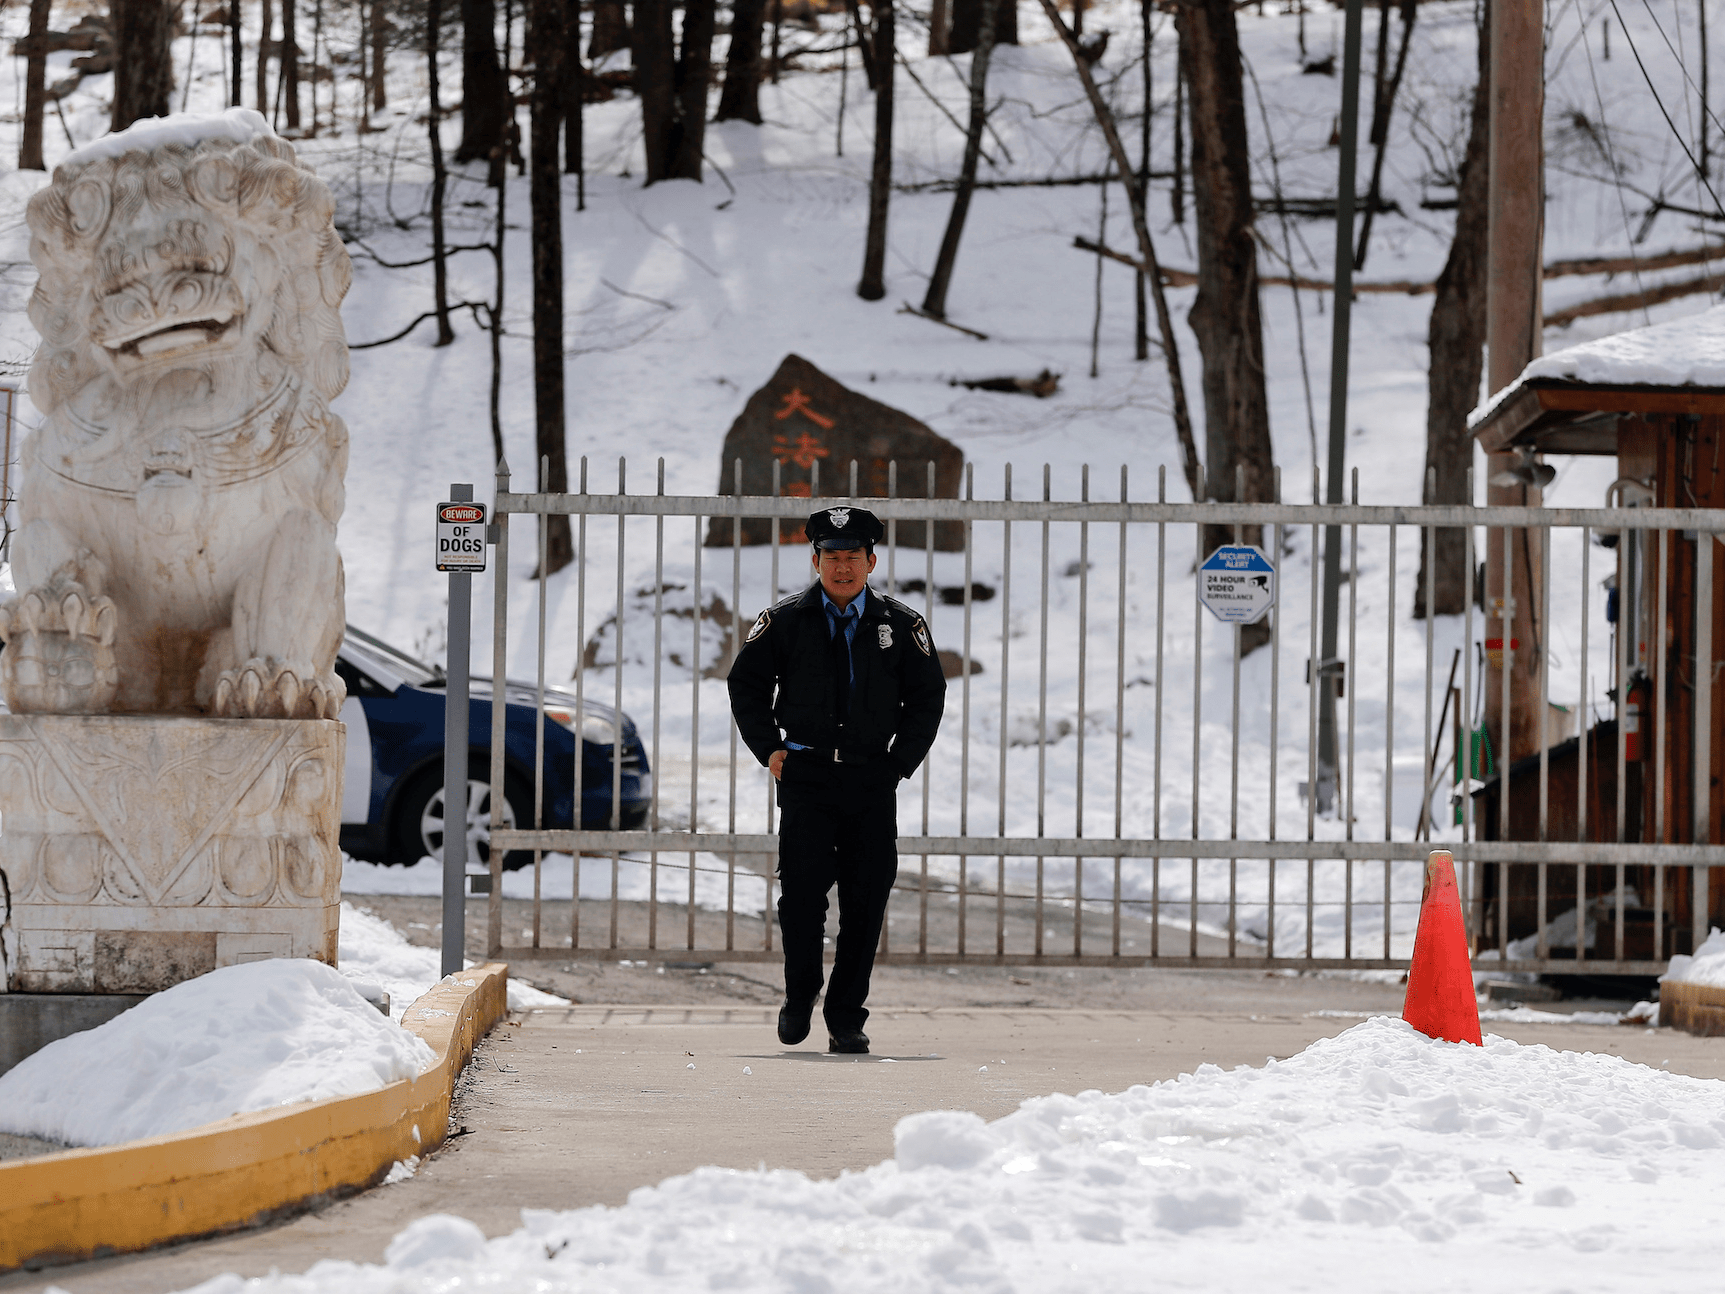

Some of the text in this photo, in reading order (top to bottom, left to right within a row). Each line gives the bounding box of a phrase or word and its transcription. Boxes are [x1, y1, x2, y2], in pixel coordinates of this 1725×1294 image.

[446, 509, 477, 519] BEWARE
[453, 526, 470, 537] OF
[440, 538, 482, 552] DOGS
[1218, 552, 1256, 560] SECURITY
[1207, 575, 1246, 584] 24 HOUR
